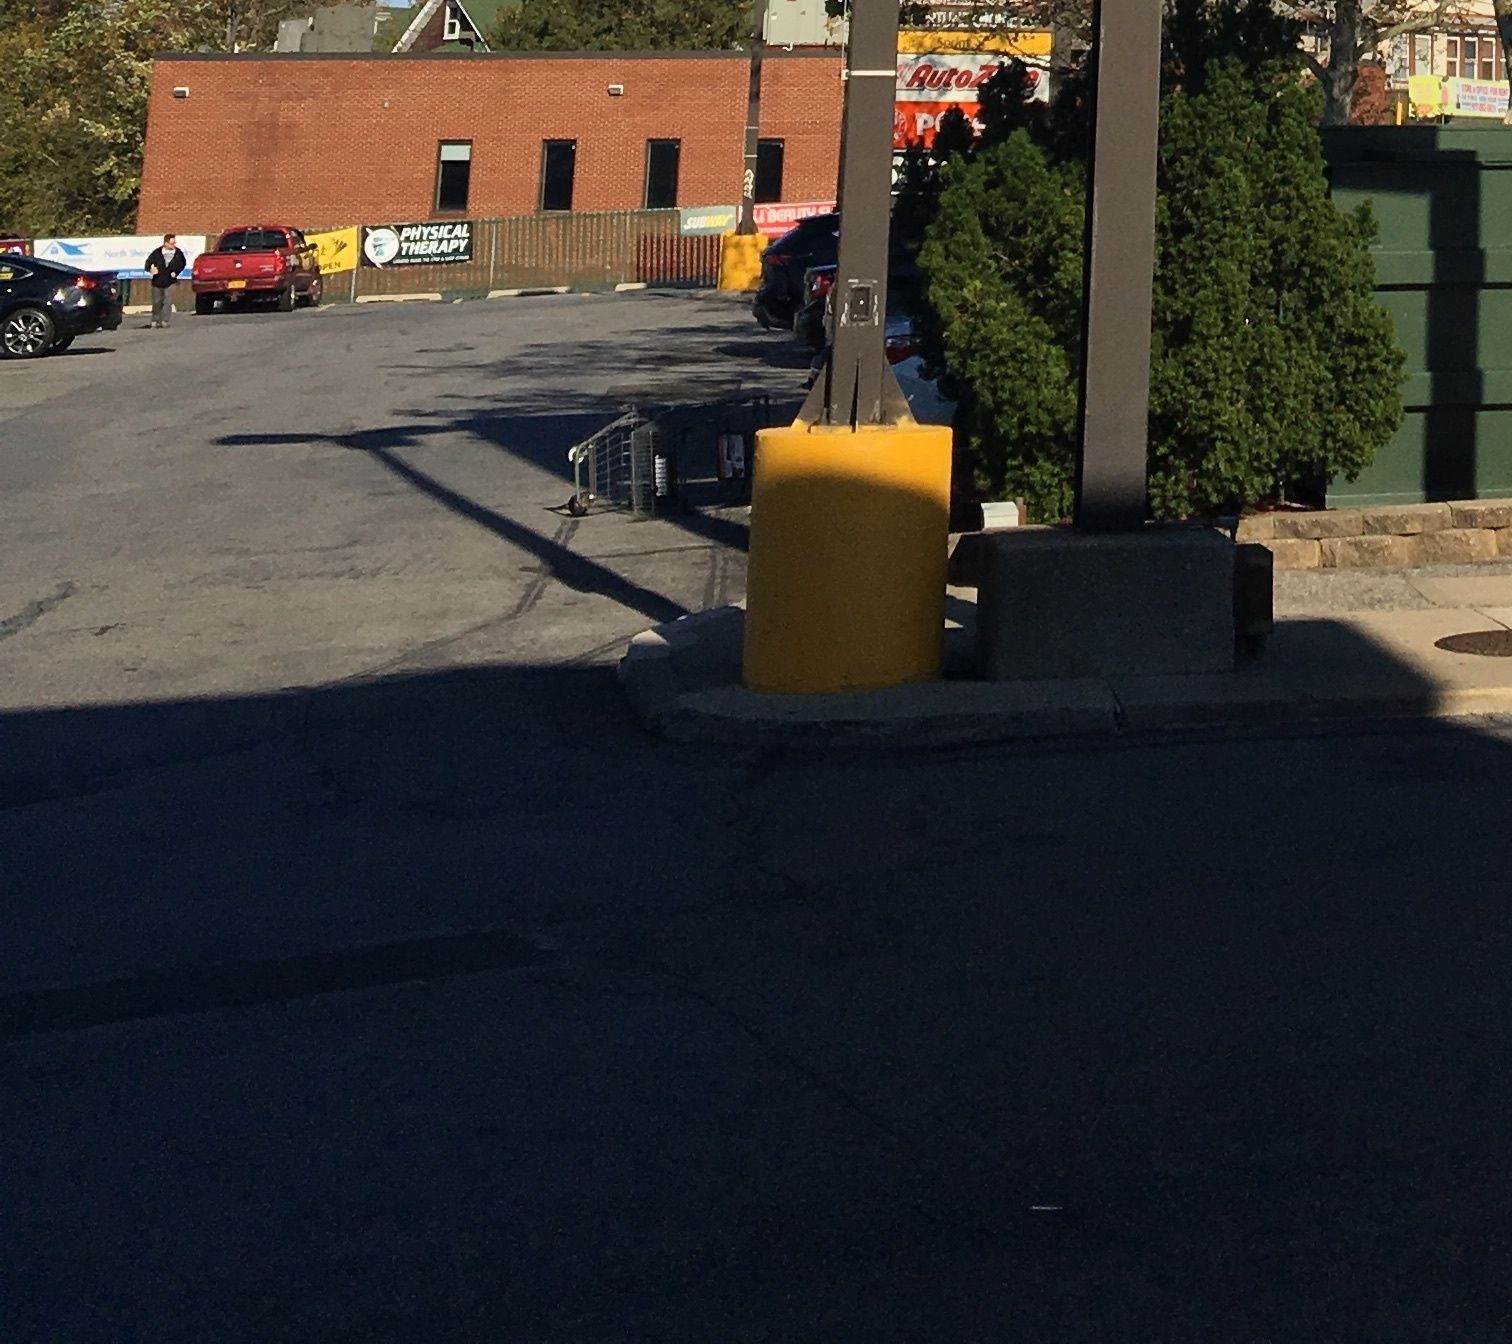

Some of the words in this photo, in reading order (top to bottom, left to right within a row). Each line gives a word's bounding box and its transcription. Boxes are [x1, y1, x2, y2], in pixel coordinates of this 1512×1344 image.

[906, 64, 1040, 89] AutoZe
[684, 214, 734, 230] SUBWAY
[400, 224, 470, 240] PHYSICAL
[400, 239, 469, 256] THERAPY
